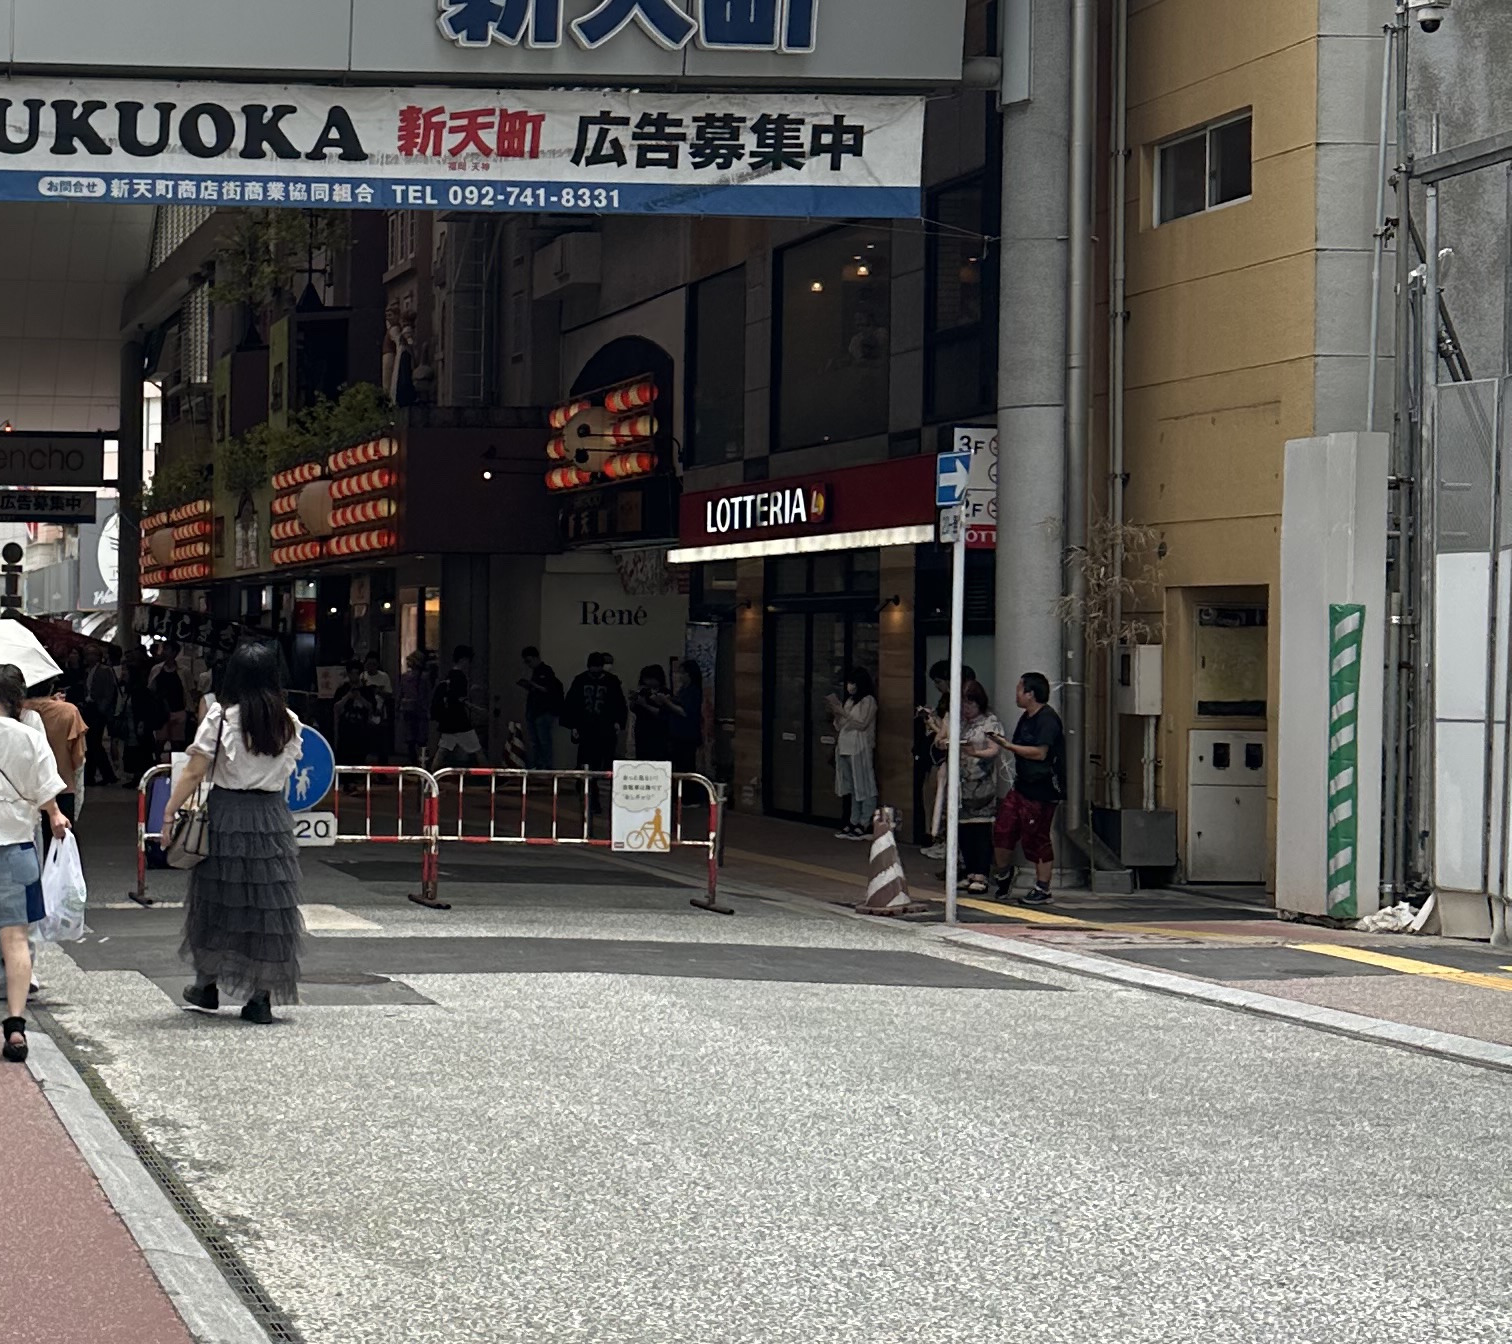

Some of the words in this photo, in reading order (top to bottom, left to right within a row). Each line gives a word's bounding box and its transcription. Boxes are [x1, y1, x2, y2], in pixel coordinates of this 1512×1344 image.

[397, 104, 546, 159] 新天町
[570, 110, 864, 171] 広告募集中
[47, 181, 97, 193] お問合せ
[110, 179, 375, 203] 新天町商店街商業協同組合
[392, 186, 437, 205] TEL
[448, 186, 620, 208] 092-741-8331
[959, 436, 985, 455] 3F
[0, 495, 82, 511] 広告募集中
[707, 488, 806, 533] LOTTERIA
[578, 601, 647, 626] René
